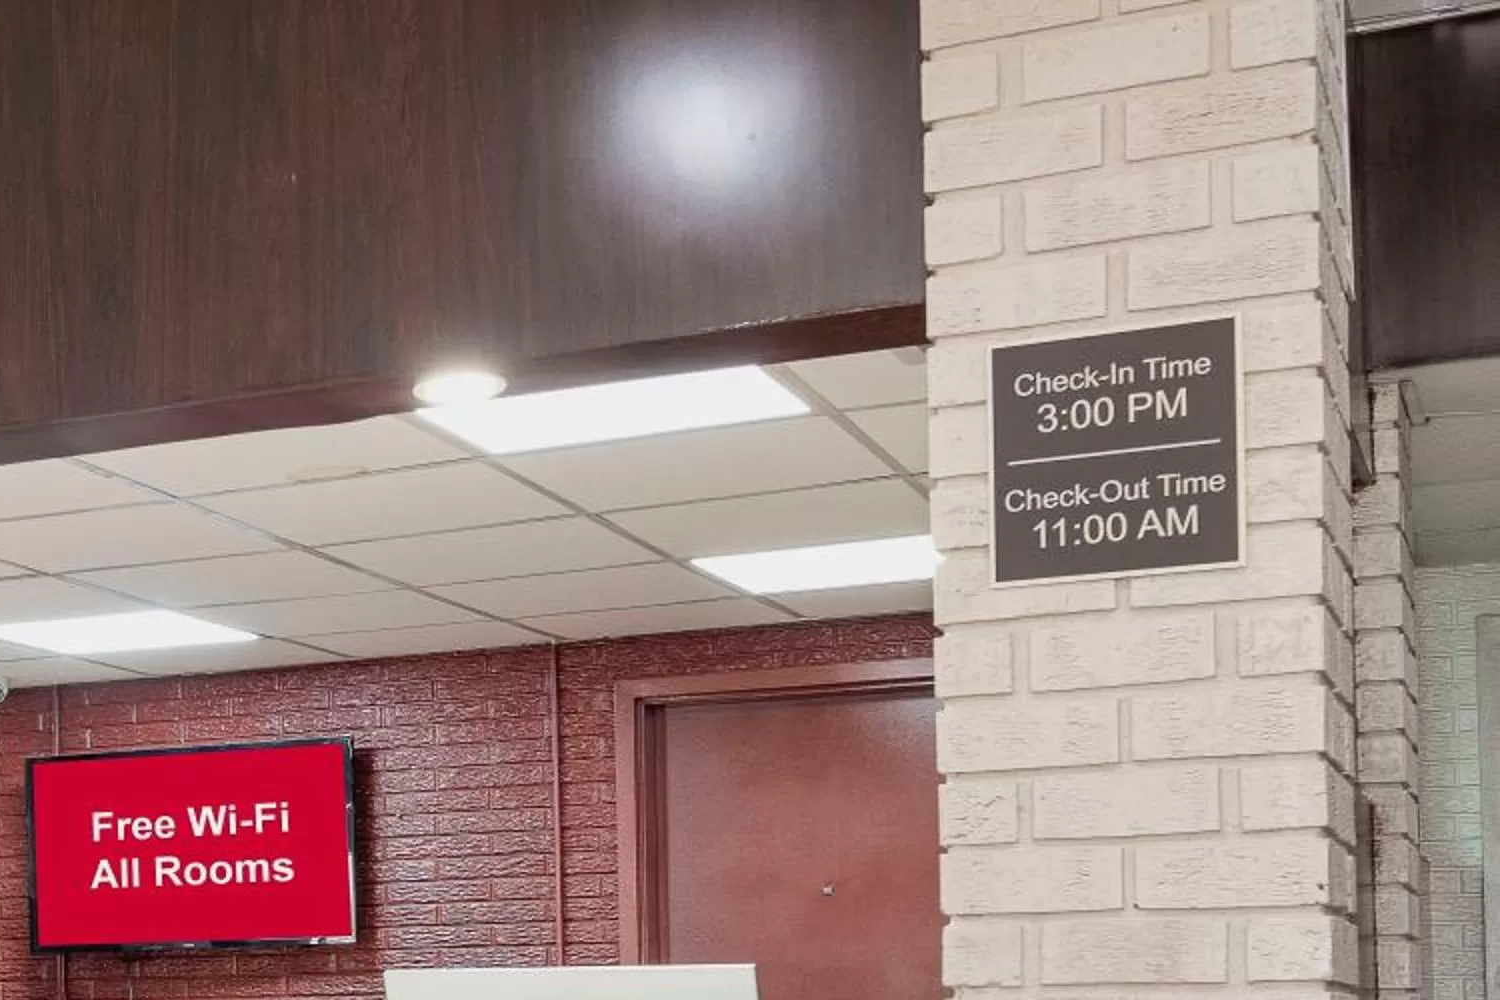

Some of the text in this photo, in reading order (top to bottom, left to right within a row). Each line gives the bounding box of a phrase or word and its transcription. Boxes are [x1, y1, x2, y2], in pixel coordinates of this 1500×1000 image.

[1013, 356, 1213, 397] Check-In Time
[1037, 387, 1188, 433] 3:00 PM
[1004, 472, 1227, 513] Check-Out Time
[1032, 504, 1200, 548] 11:00 AM
[92, 801, 290, 842] Free Wi-Fi
[90, 855, 295, 889] All Rooms
